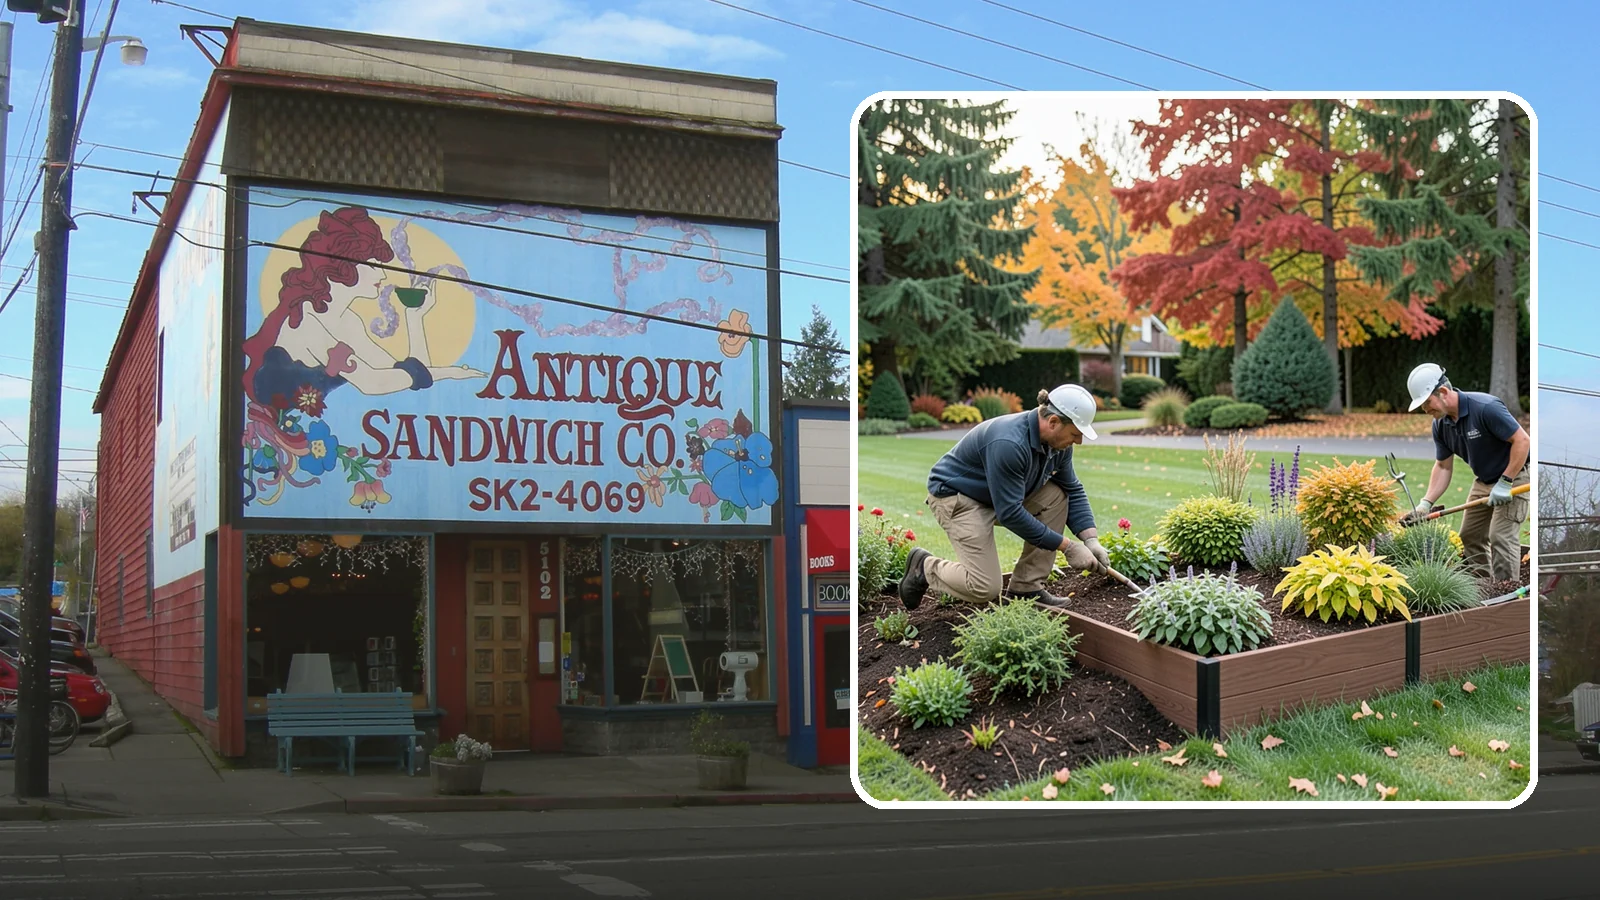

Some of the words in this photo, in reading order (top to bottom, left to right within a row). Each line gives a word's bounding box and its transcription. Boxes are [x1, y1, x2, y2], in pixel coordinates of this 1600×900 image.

[475, 328, 724, 421] ANTIQUE
[361, 408, 605, 468] SANDWICH
[616, 420, 685, 470] CO.
[468, 477, 646, 513] SK2-4069
[540, 541, 552, 600] 5102
[809, 554, 835, 569] BOOKS
